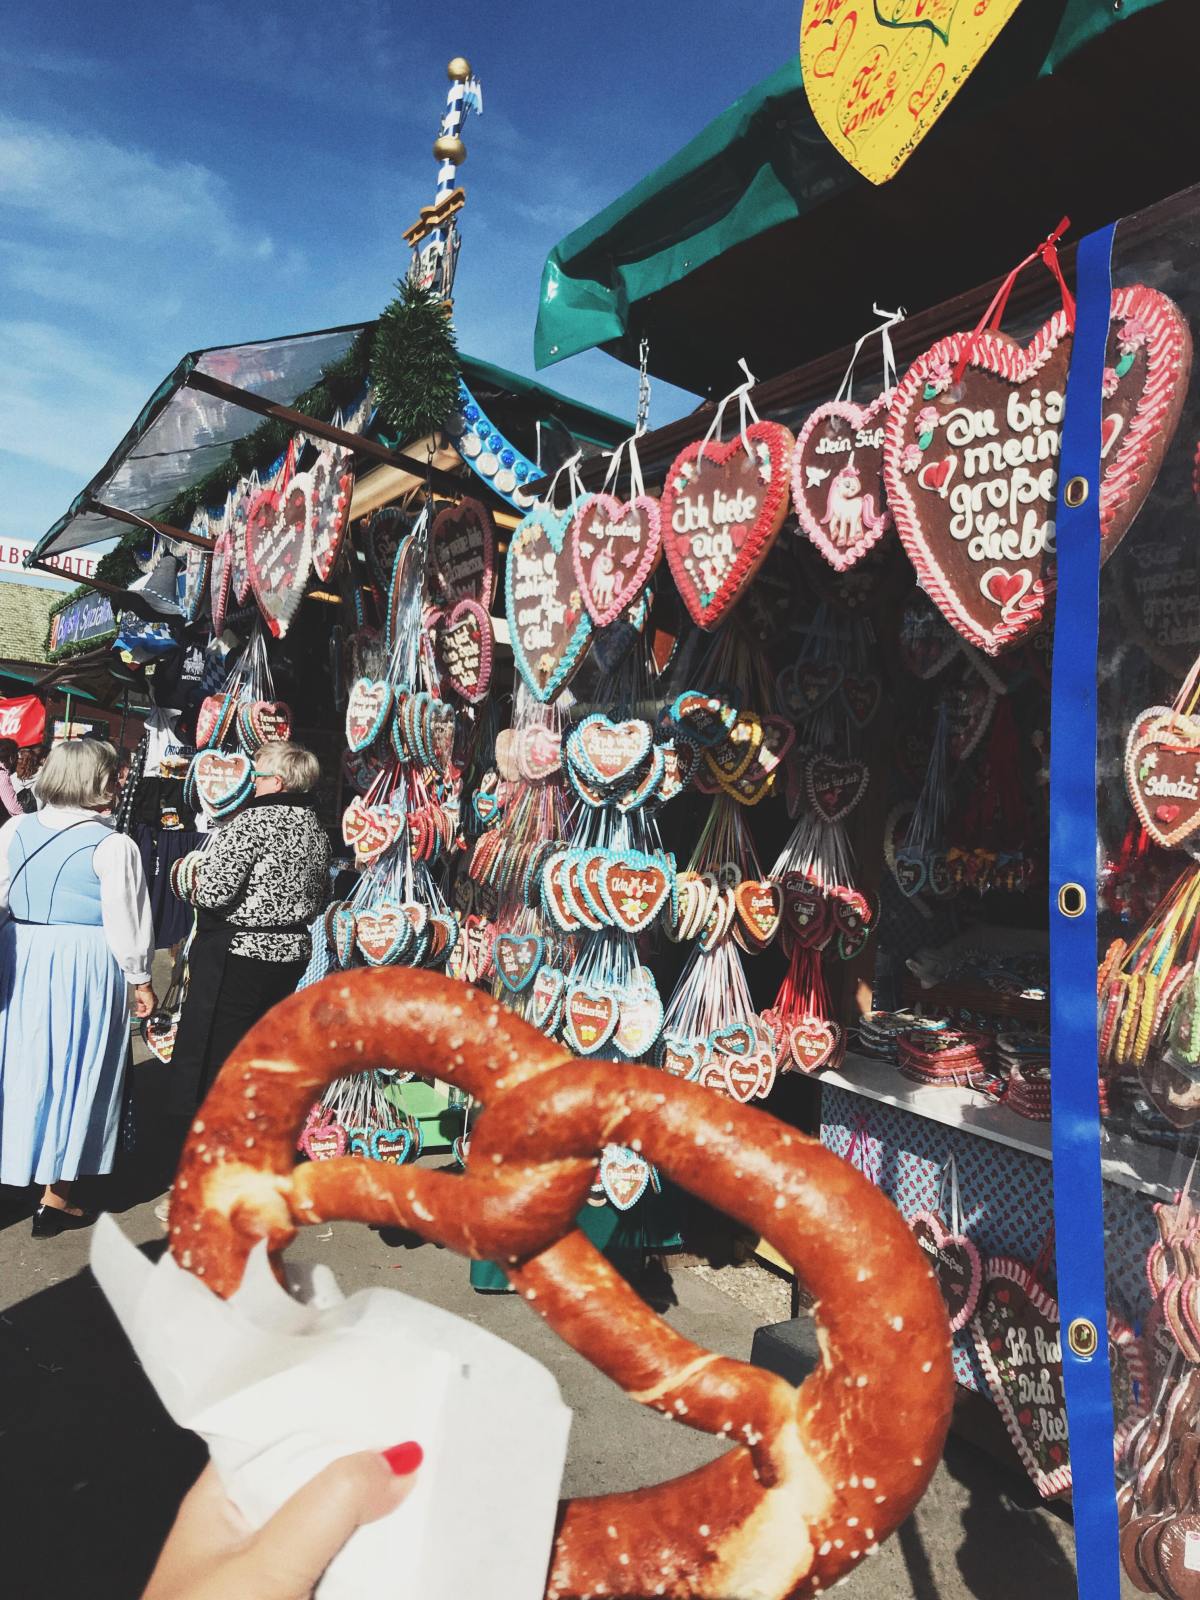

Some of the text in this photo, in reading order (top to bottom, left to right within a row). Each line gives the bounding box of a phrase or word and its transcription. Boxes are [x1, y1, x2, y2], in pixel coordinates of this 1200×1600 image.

[1006, 388, 1066, 434] bis
[855, 427, 886, 450] Süß
[963, 427, 1062, 478] mein
[672, 488, 757, 533] Ich liebe
[1144, 774, 1199, 801] Schatzi
[572, 1000, 609, 1020] Oktoberfest
[1004, 1327, 1034, 1367] Ich
[1017, 1368, 1056, 1405] Dich
